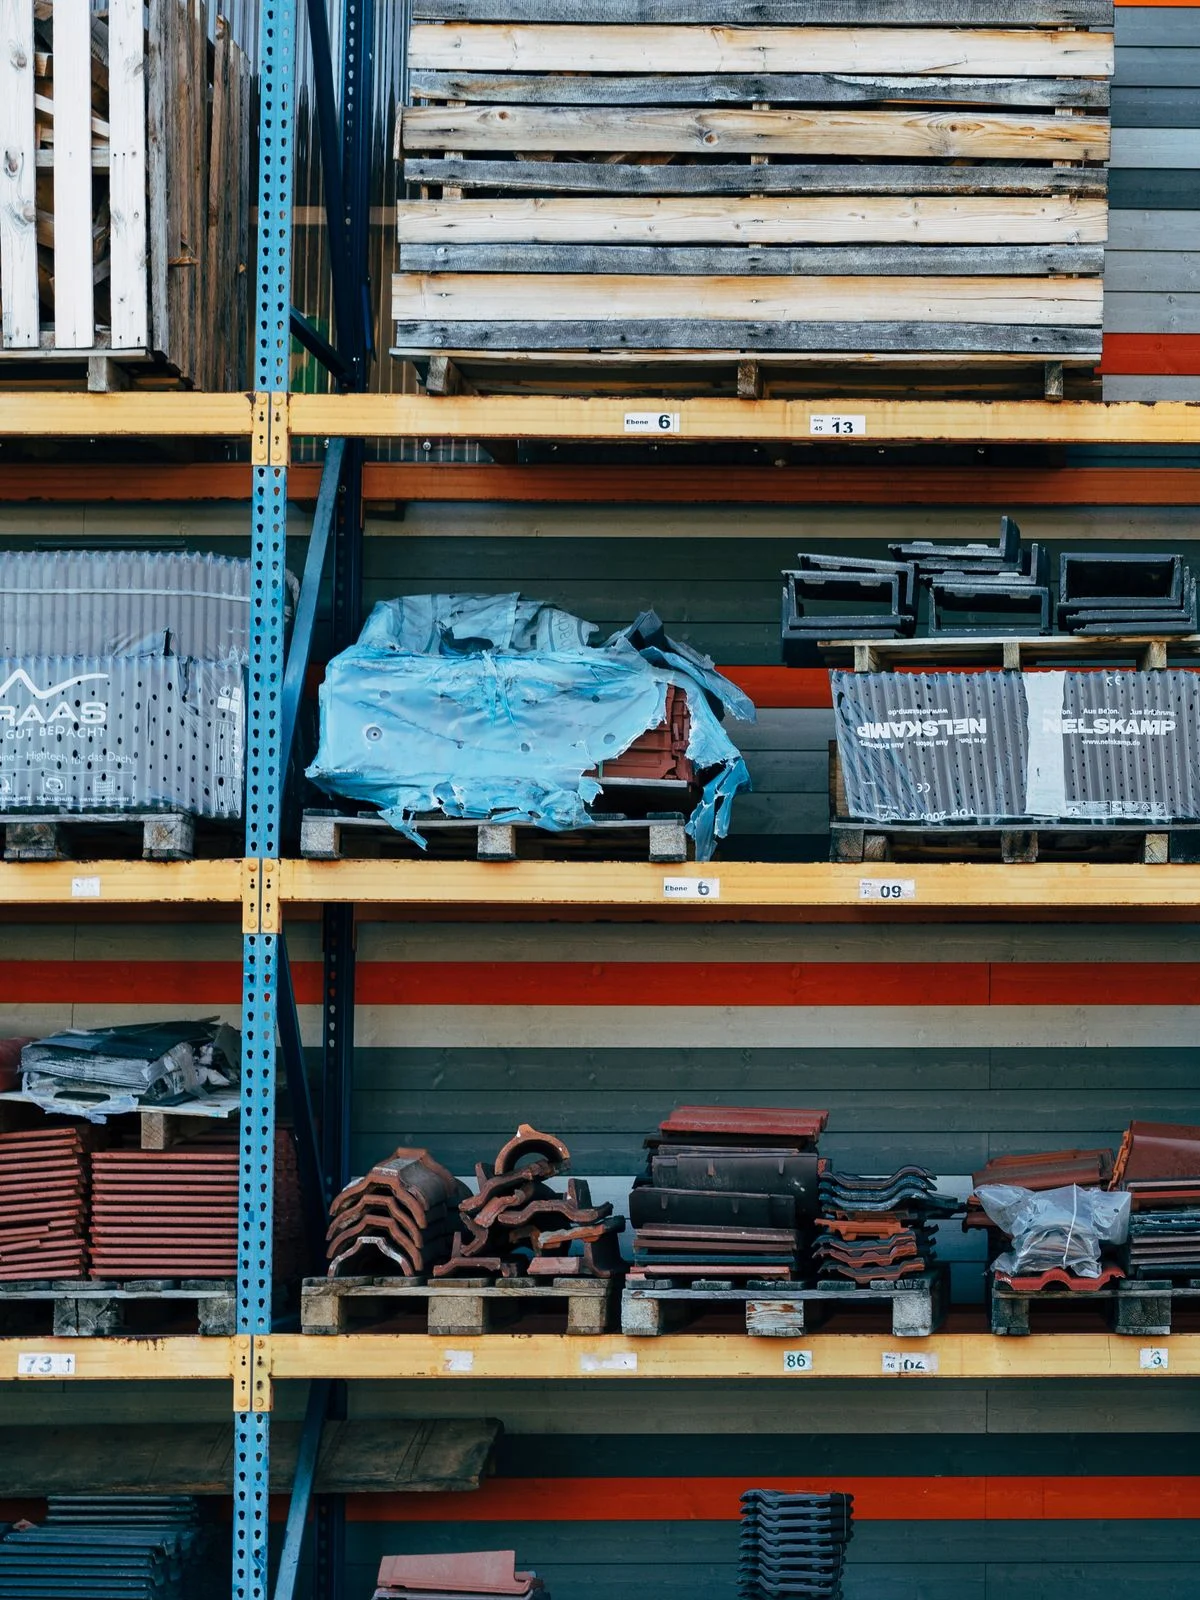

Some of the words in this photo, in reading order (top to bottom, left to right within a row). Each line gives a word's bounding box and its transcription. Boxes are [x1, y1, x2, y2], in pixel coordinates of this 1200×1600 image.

[658, 414, 671, 429] 6
[832, 421, 854, 433] 13
[5, 728, 34, 740] GUT
[857, 718, 987, 739] NELSKAMP
[26, 751, 68, 764] Hightech
[88, 752, 104, 762] das
[107, 751, 135, 765] Dach.
[950, 808, 975, 818] TOP
[697, 881, 710, 896] 6
[881, 885, 902, 898] 09
[24, 1356, 53, 1372] 73
[787, 1353, 806, 1368] 86
